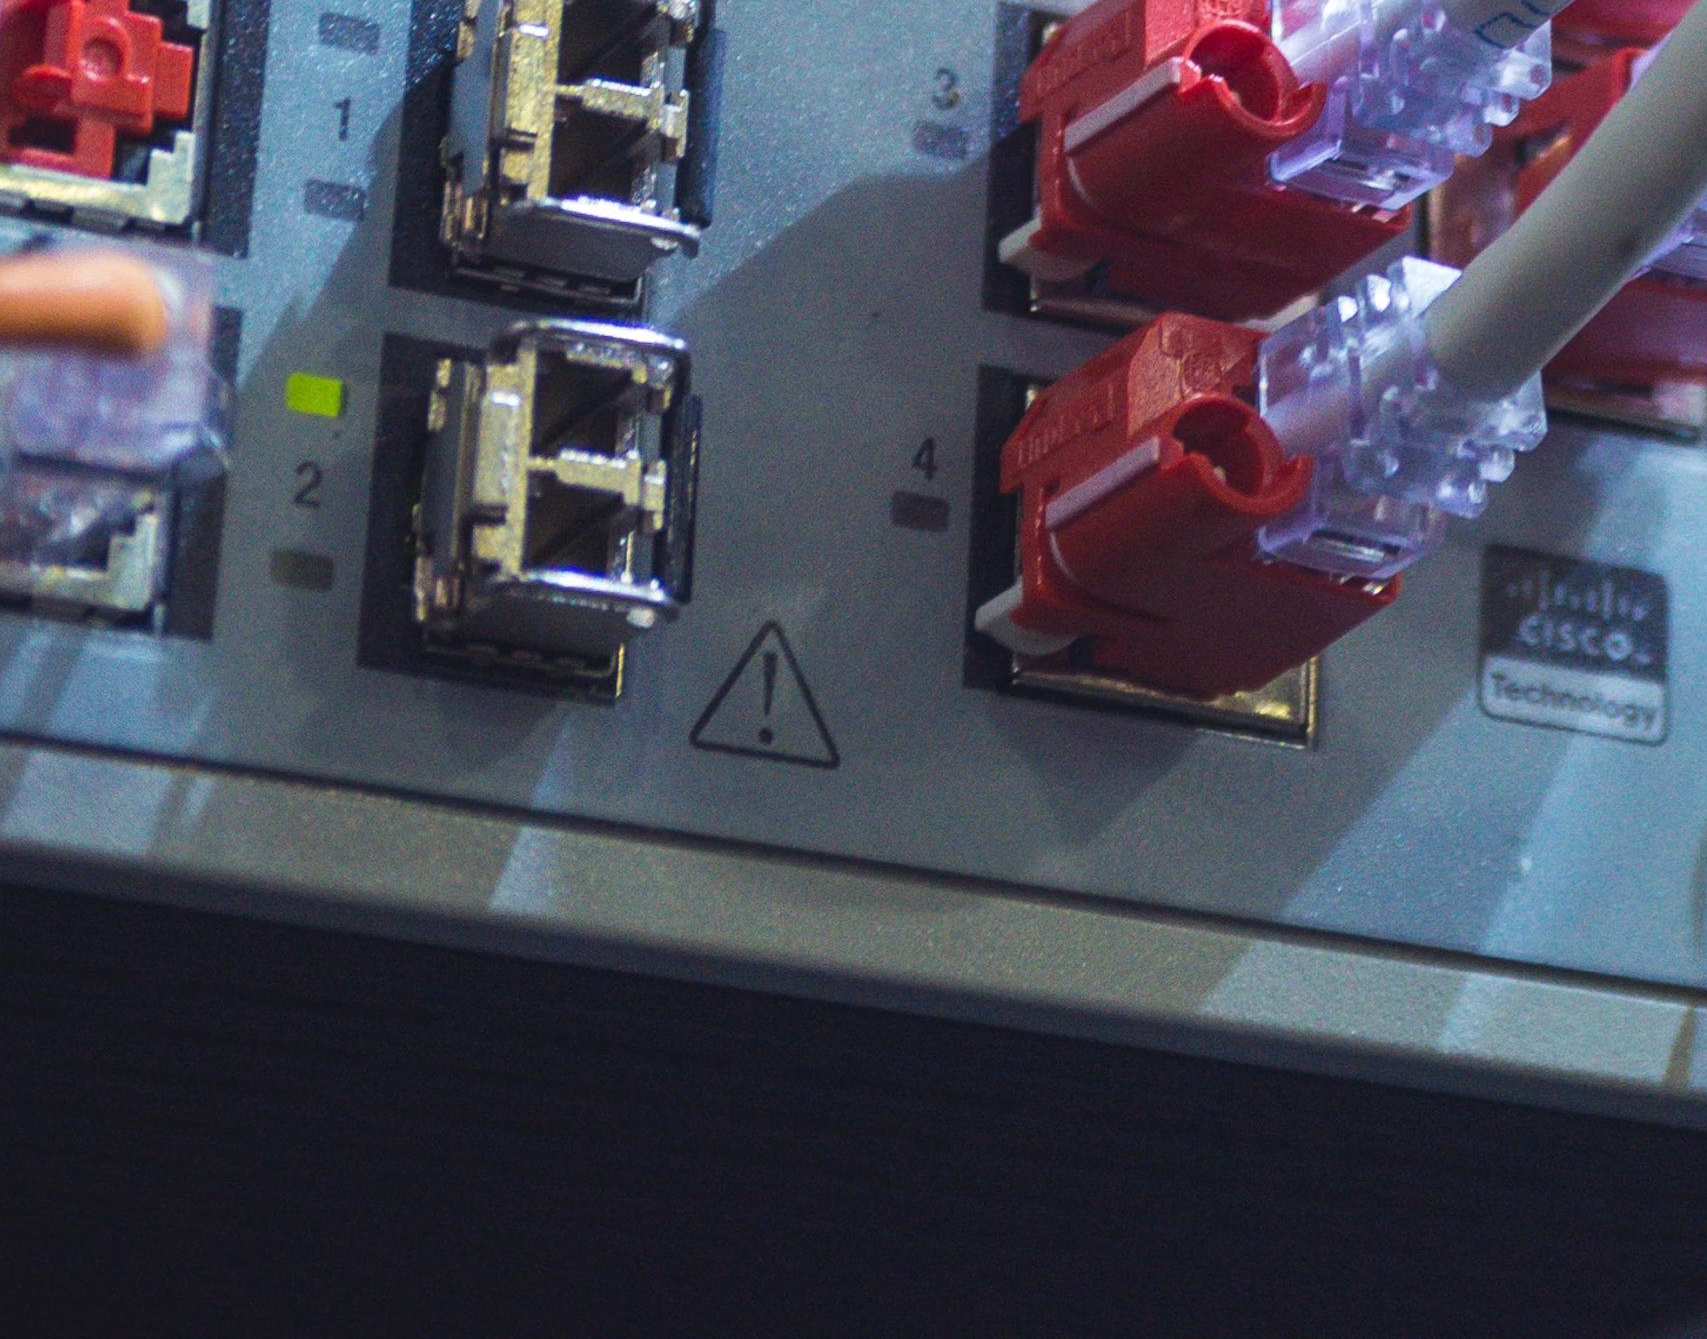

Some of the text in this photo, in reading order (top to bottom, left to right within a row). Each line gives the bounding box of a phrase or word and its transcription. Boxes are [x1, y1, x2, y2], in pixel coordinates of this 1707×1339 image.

[933, 66, 962, 110] 3
[334, 97, 354, 142] 1
[910, 435, 940, 482] 4
[292, 459, 325, 508] 2
[1490, 671, 1658, 731] Technology
